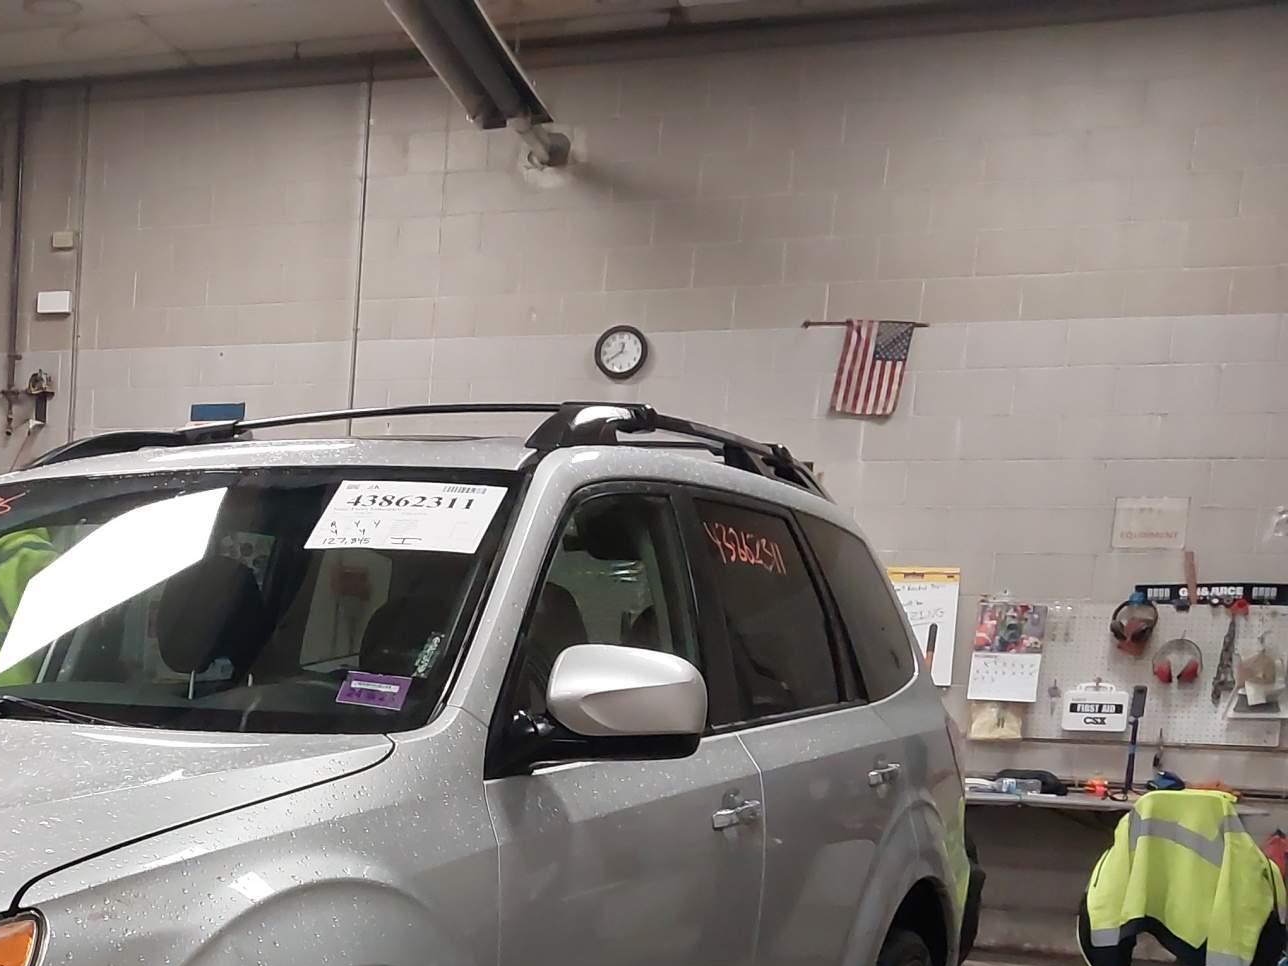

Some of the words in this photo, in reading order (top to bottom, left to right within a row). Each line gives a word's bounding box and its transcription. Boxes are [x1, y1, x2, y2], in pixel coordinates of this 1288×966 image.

[347, 493, 475, 510] 43862311
[1077, 703, 1100, 713] FIRST
[1101, 704, 1116, 713] AID
